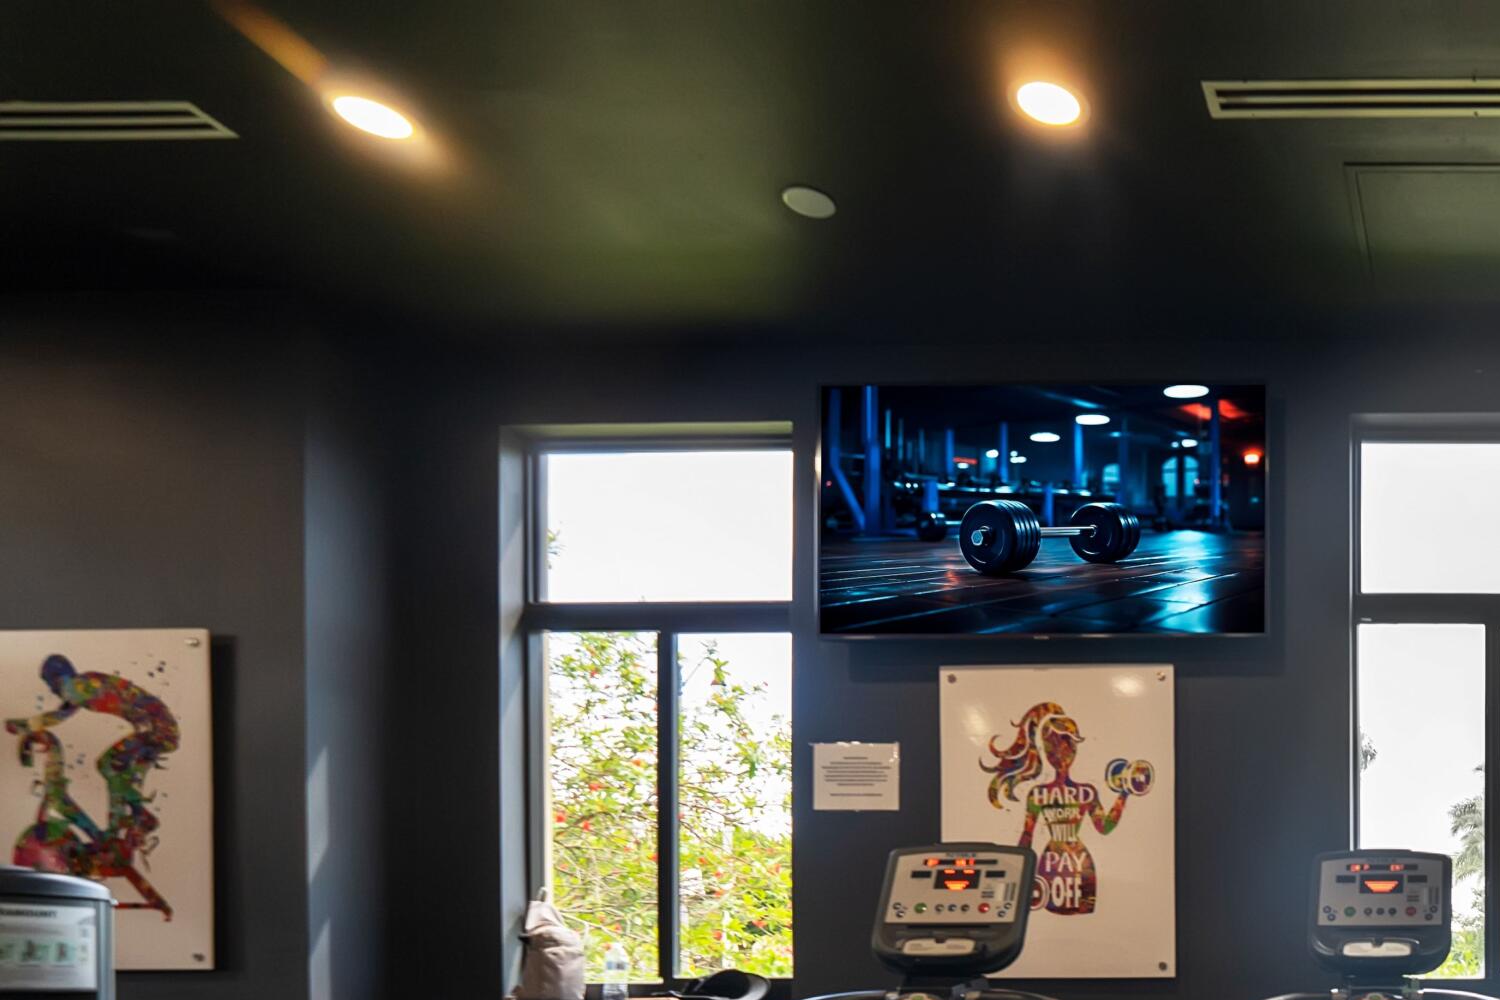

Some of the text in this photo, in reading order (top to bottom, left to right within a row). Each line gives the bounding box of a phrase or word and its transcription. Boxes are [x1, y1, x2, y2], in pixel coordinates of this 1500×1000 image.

[1033, 786, 1095, 804] HARD
[1043, 808, 1081, 820] WORK
[1050, 823, 1079, 842] WILL
[1045, 851, 1086, 872] PAY
[1051, 876, 1083, 908] OFF
